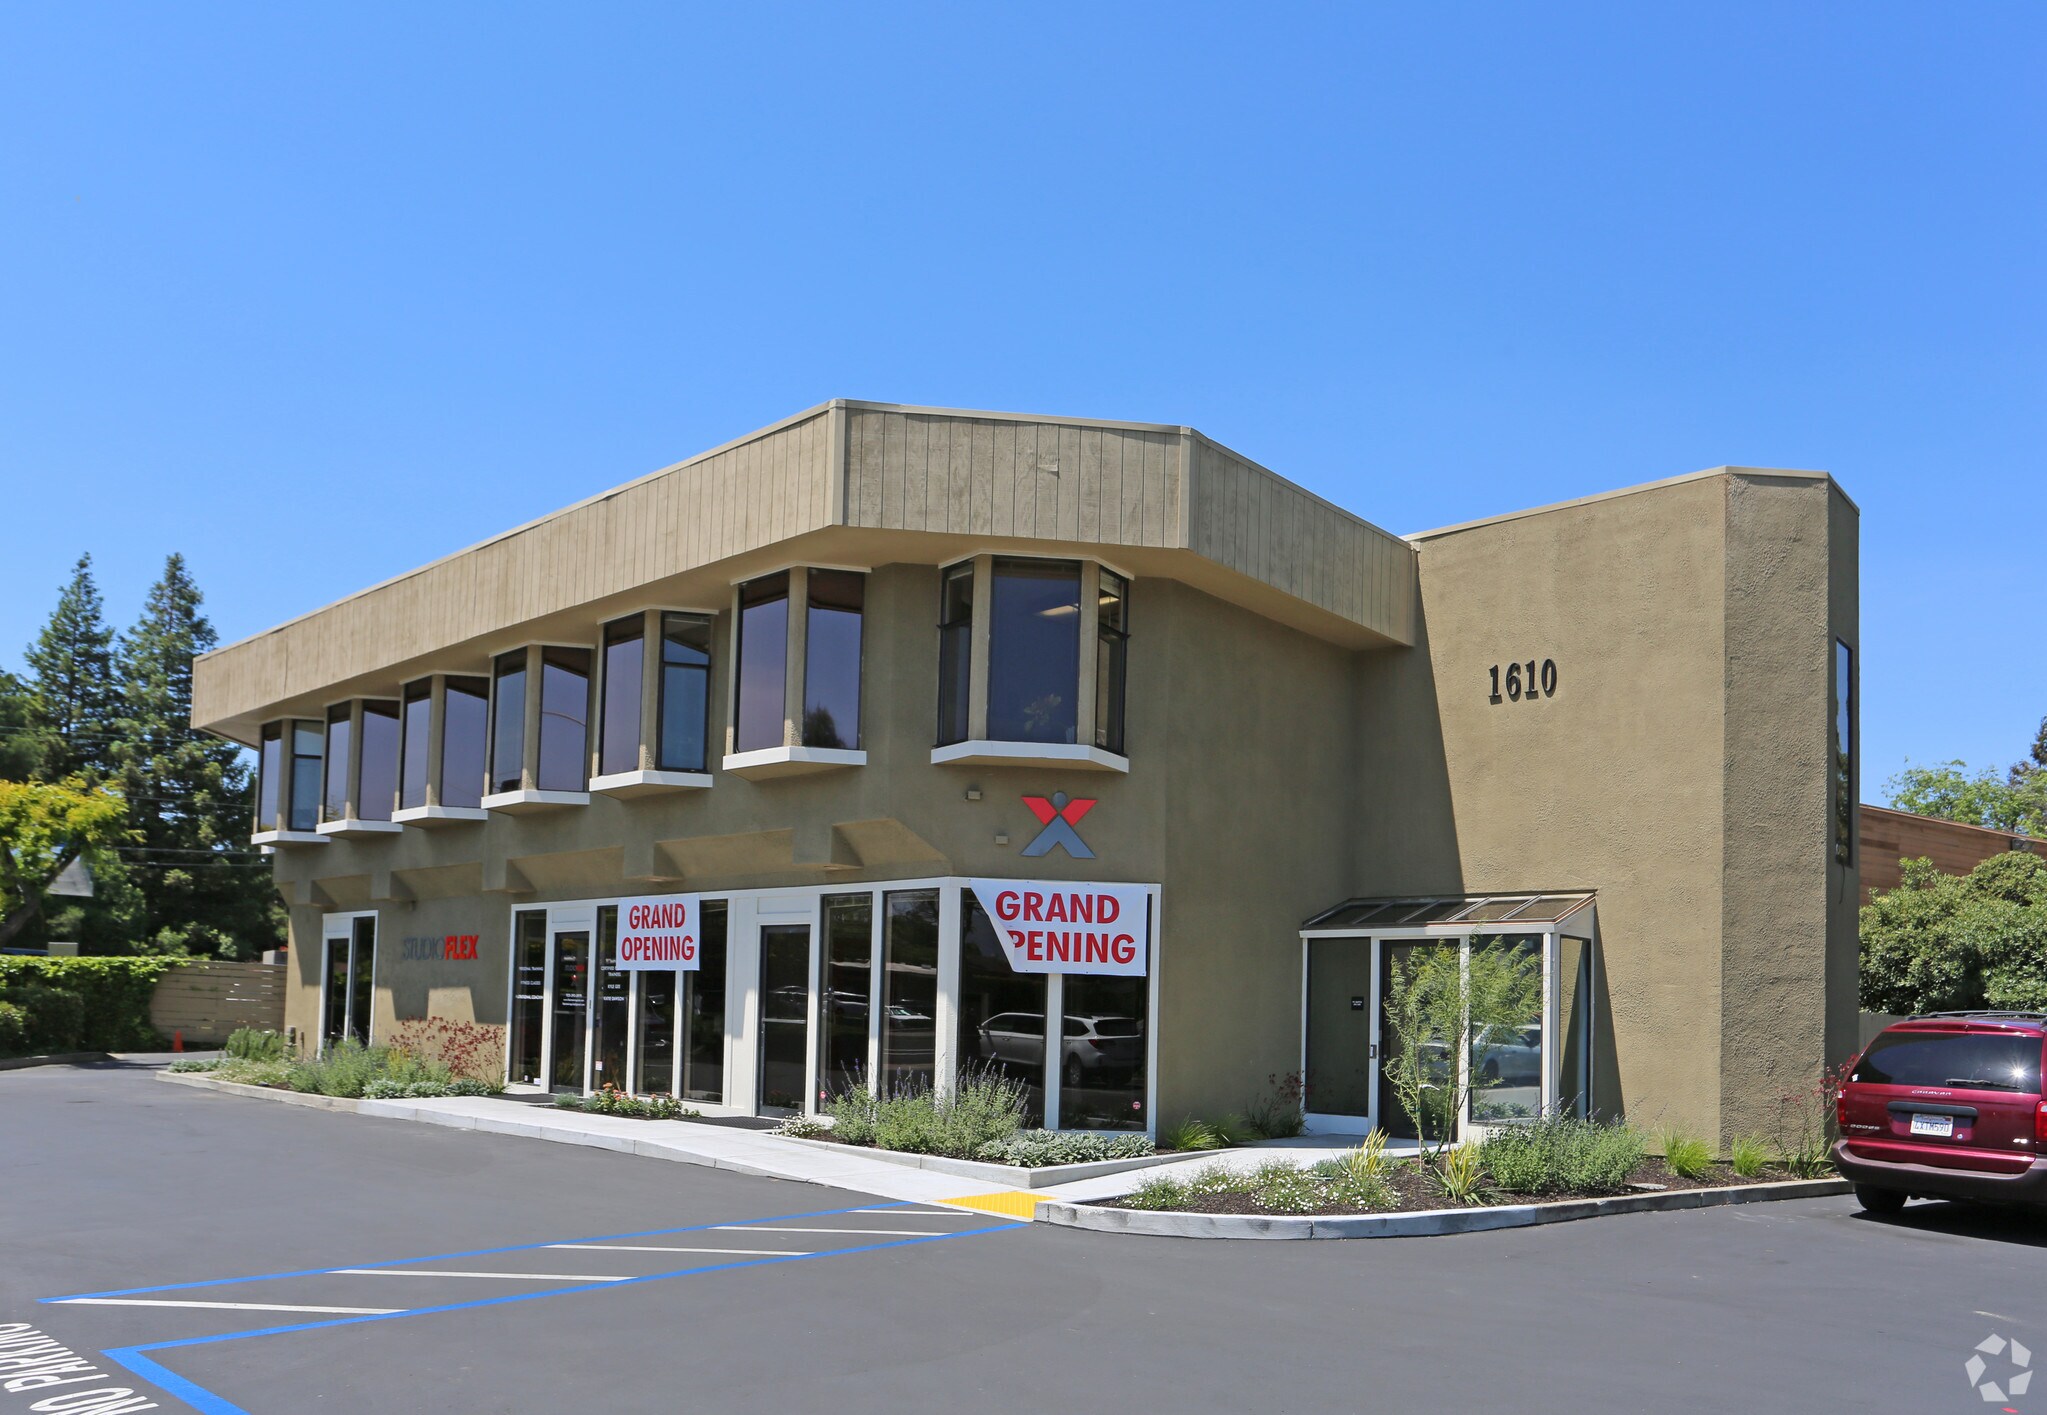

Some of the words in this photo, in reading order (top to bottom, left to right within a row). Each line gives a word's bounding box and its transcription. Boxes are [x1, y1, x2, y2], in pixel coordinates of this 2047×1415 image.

[1488, 658, 1557, 699] 1610
[629, 903, 686, 930] GRAND
[995, 890, 1120, 924] GRAND
[621, 935, 695, 961] OPENING
[1007, 930, 1136, 964] PENING
[29, 1387, 159, 1415] NO
